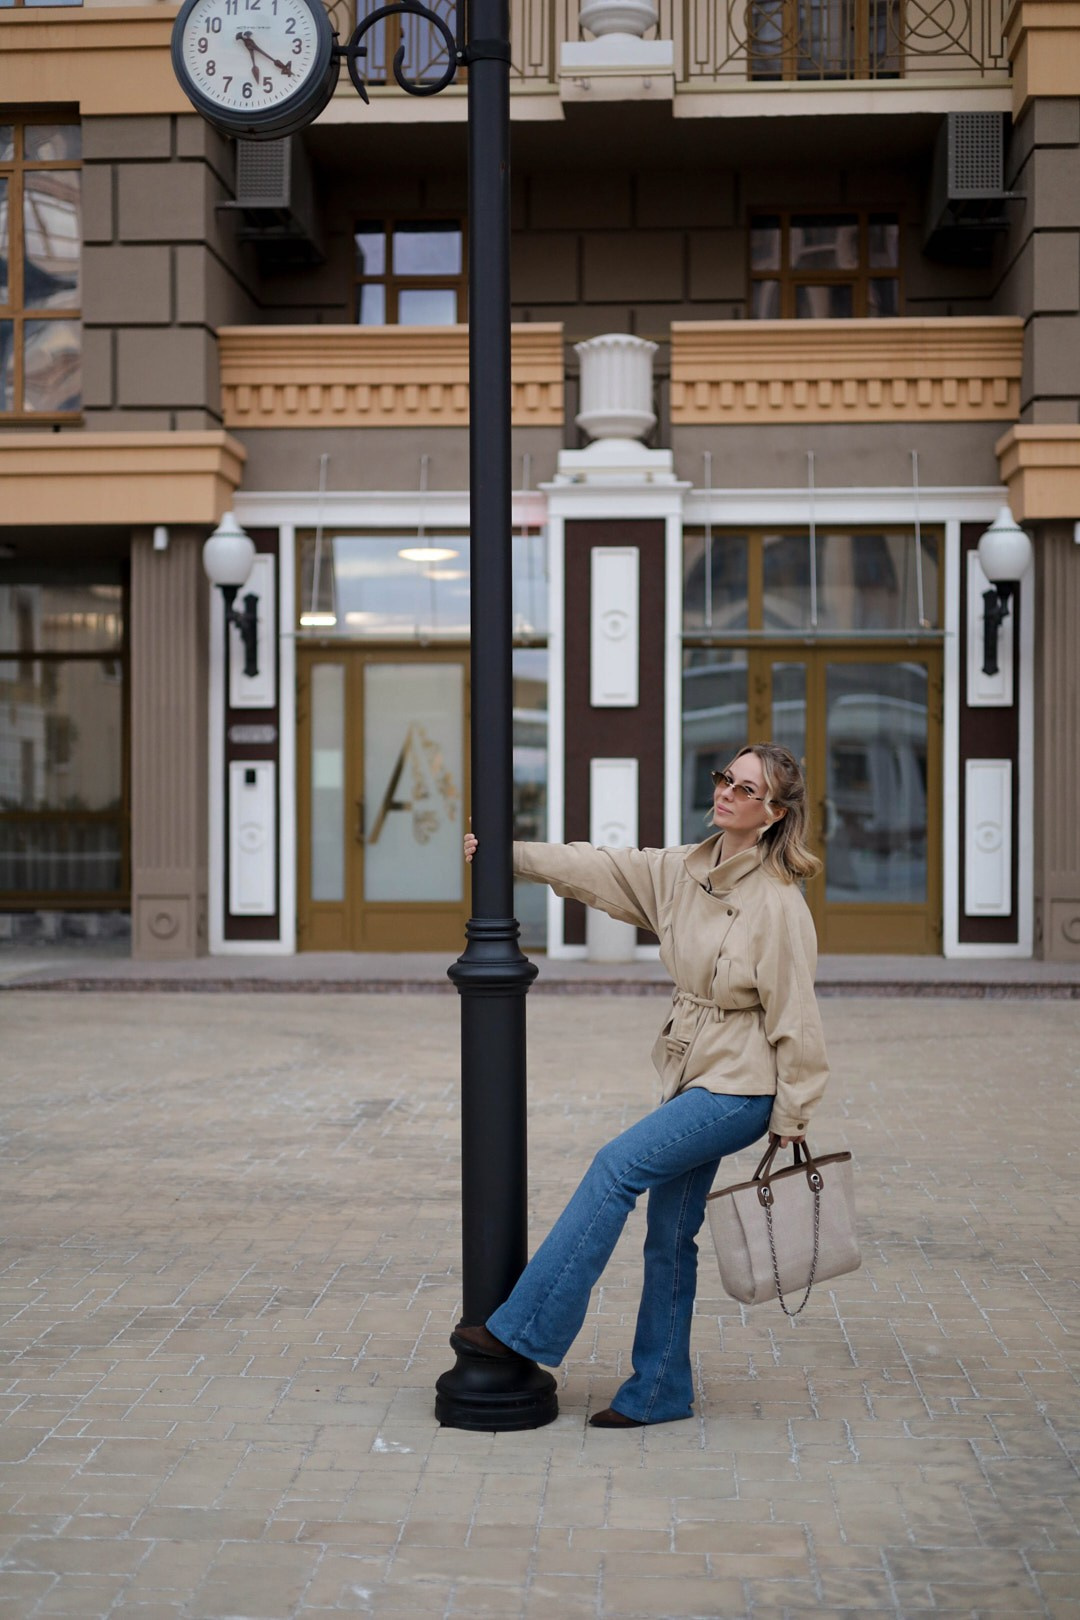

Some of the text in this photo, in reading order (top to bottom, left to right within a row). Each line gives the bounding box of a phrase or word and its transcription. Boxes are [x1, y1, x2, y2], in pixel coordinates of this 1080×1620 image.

[225, 0, 237, 15] 11
[245, 0, 261, 10] 12
[271, 0, 278, 15] 1
[204, 17, 222, 33] 10
[285, 18, 296, 34] 2
[198, 38, 208, 54] 9
[292, 38, 302, 54] 3
[206, 60, 216, 76] 8
[223, 76, 233, 93] 7
[242, 82, 252, 98] 6
[263, 77, 273, 93] 5
